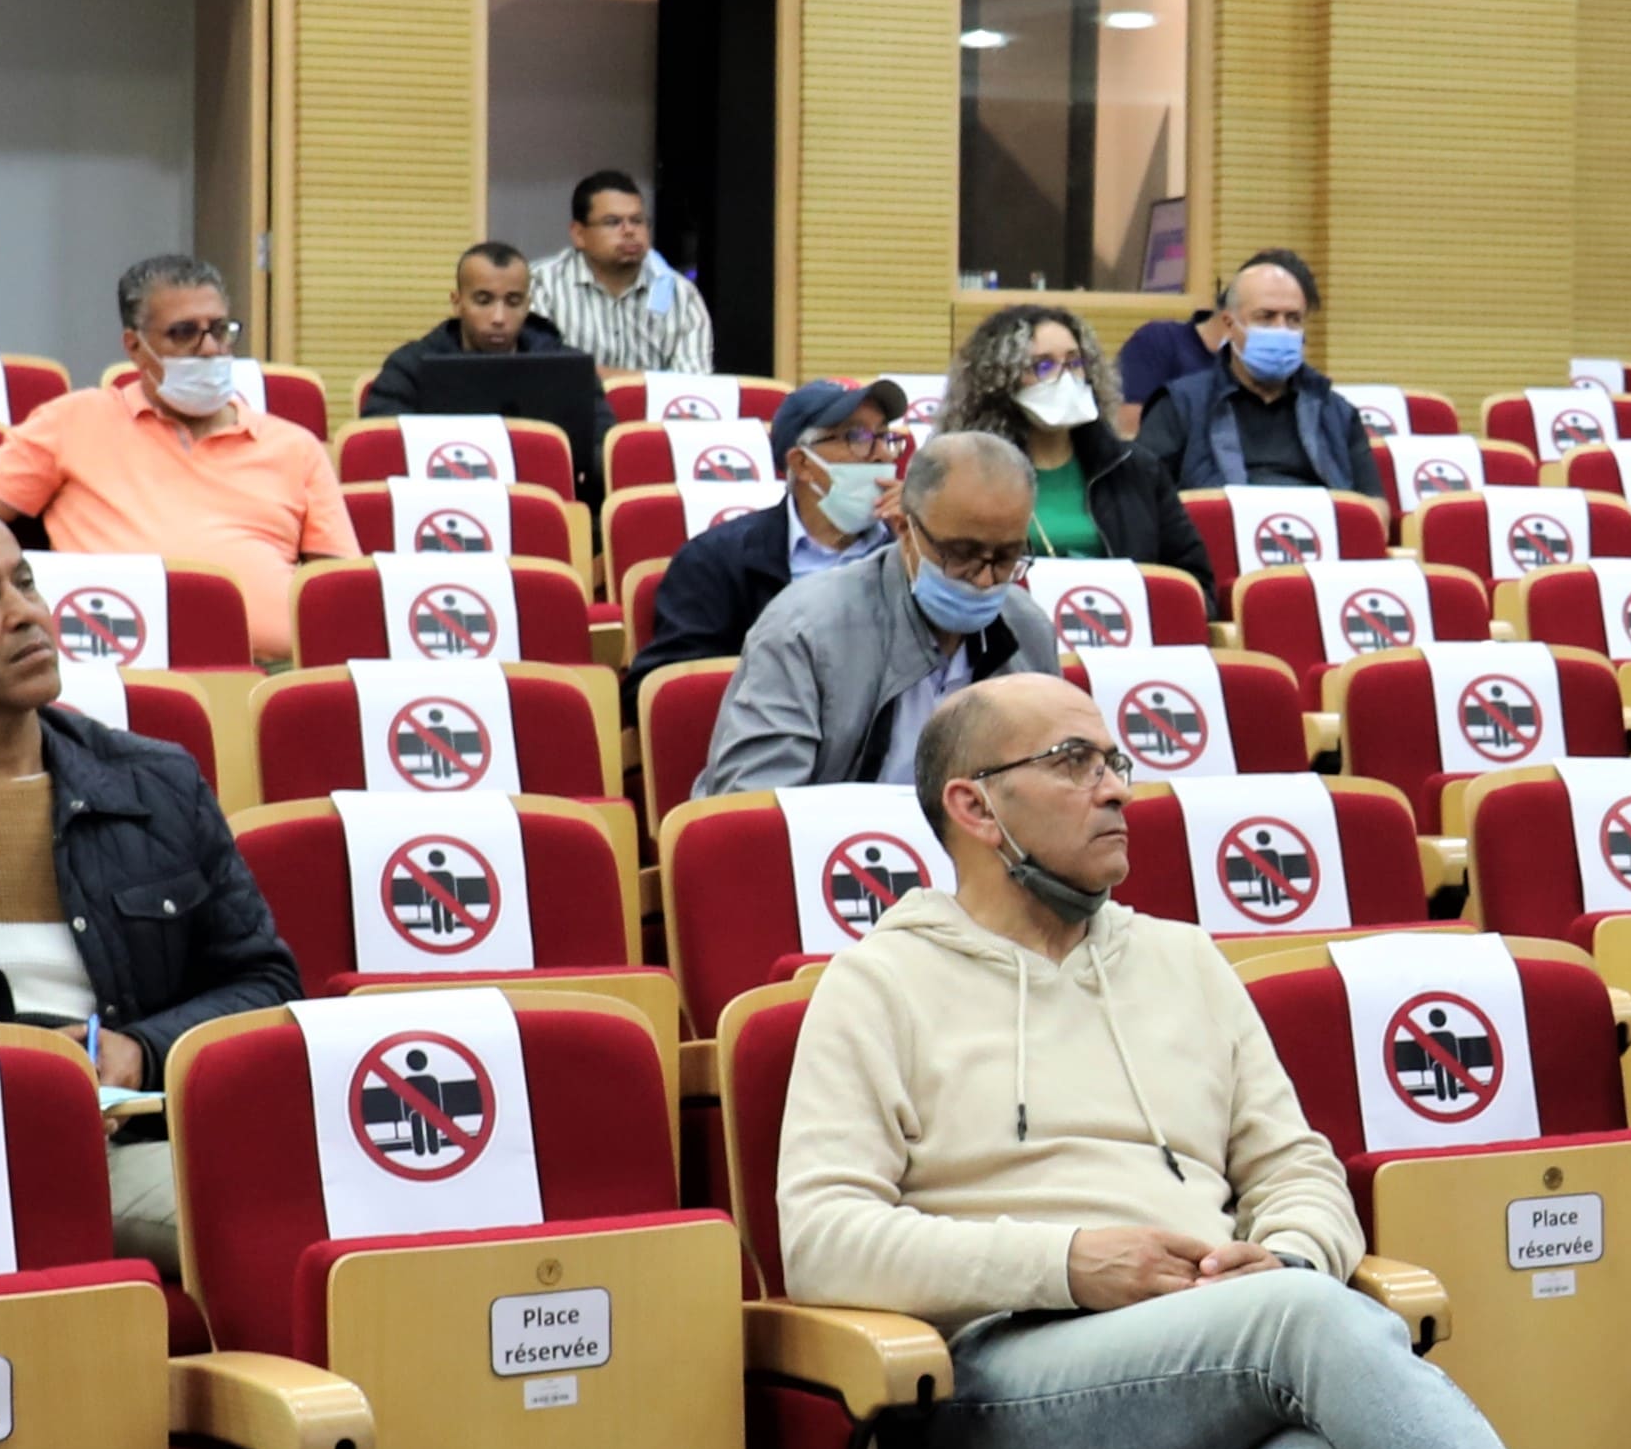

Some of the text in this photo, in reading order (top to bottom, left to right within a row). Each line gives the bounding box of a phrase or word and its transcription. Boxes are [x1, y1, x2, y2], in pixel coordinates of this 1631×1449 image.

[1532, 1209, 1579, 1229] Place
[1517, 1237, 1595, 1261] réservée
[523, 1307, 580, 1329] Place
[505, 1337, 599, 1365] réservée
